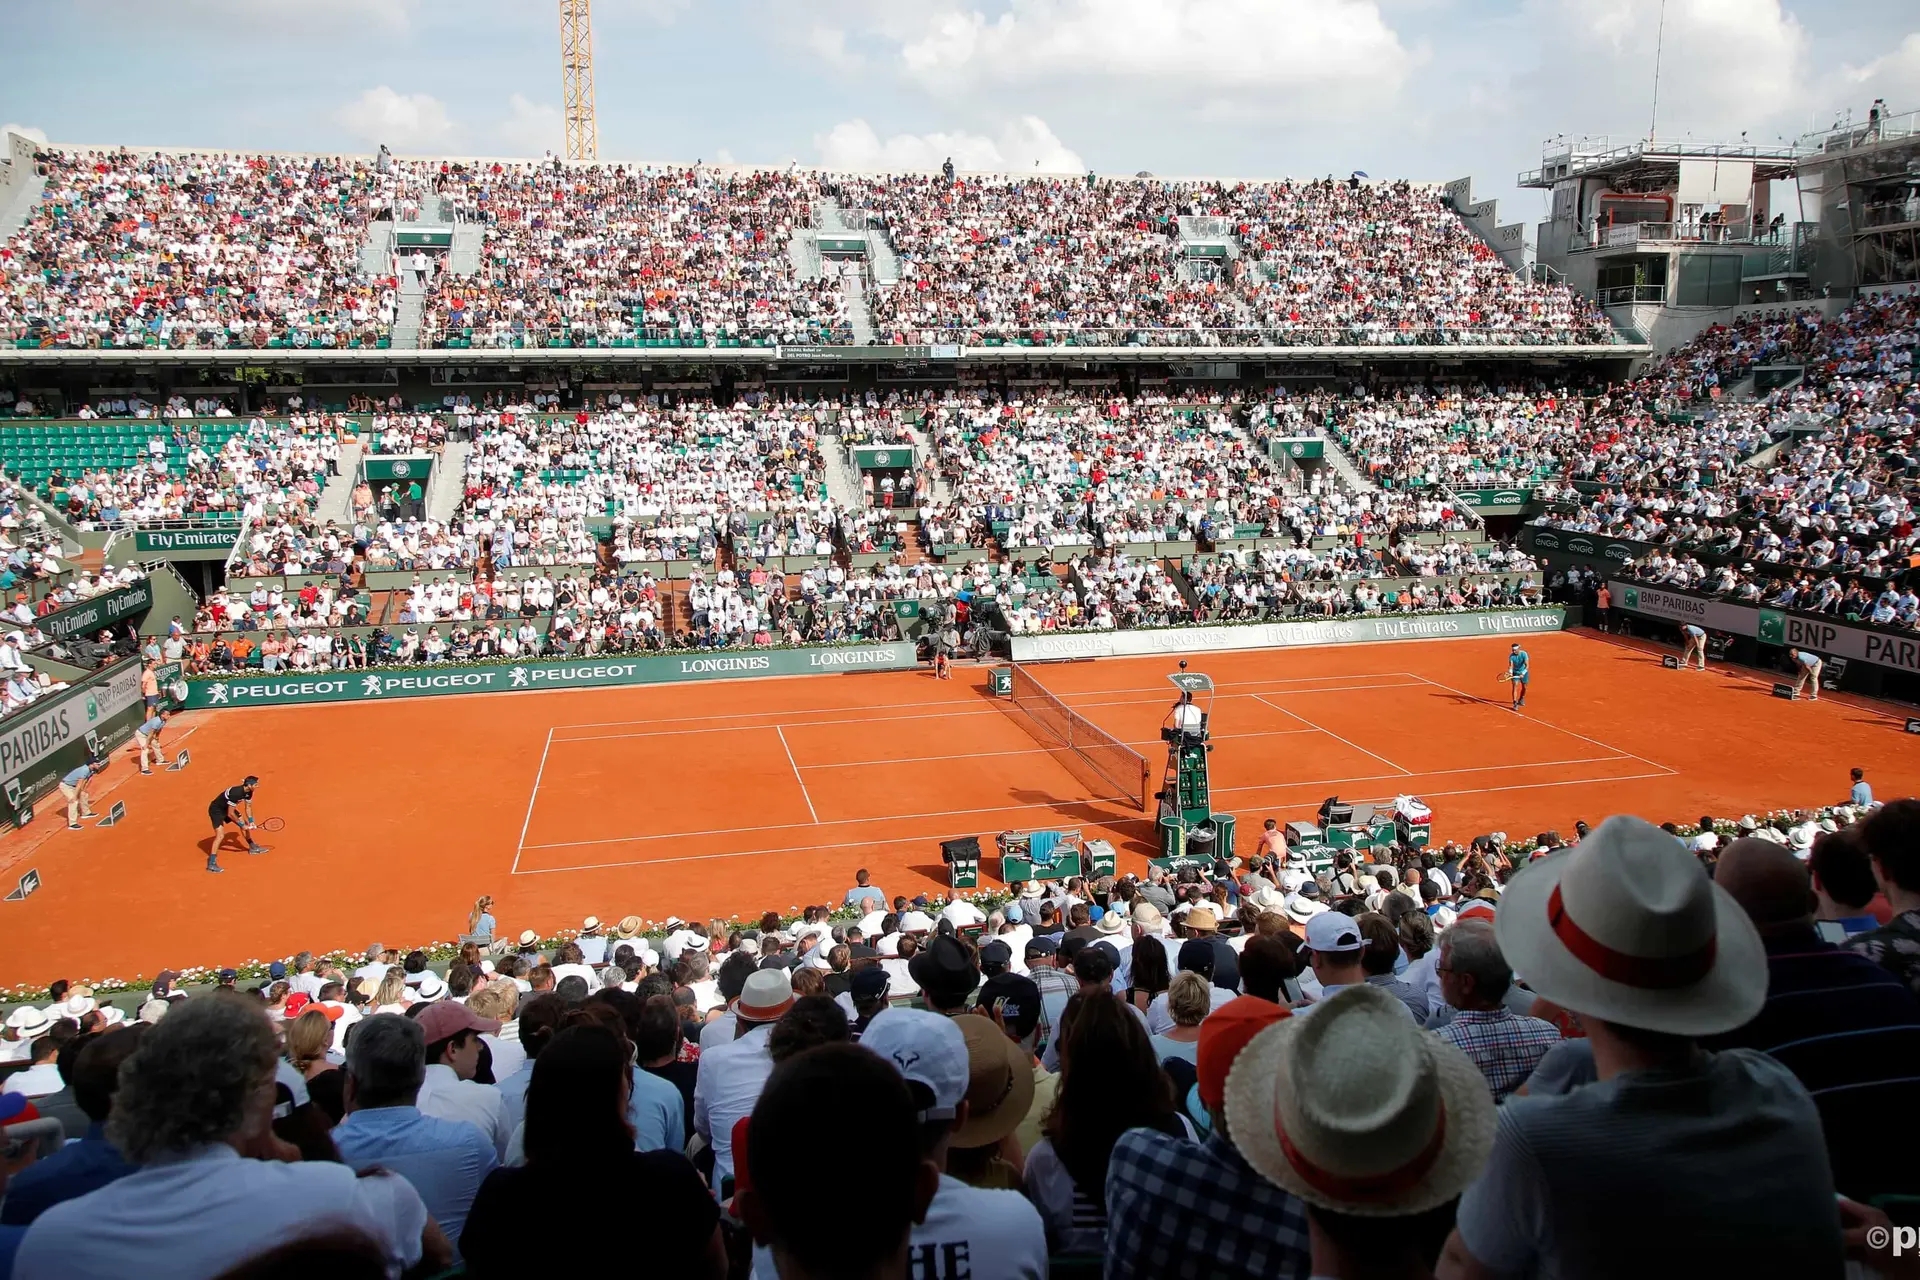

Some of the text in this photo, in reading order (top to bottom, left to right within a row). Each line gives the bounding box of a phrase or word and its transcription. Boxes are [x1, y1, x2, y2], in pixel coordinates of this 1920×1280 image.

[148, 532, 237, 548] Fly Emirates
[107, 589, 147, 616] Fly Emirates
[1641, 591, 1705, 615] BNP PARIBAS
[50, 608, 98, 635] Fly Emirates
[1375, 619, 1458, 637] Fly Emirates
[1478, 613, 1559, 632] Fly Emirates
[1151, 632, 1228, 647] LONGINES
[1266, 624, 1353, 643] Fly Emirates
[1788, 620, 1837, 649] BNP
[1032, 638, 1112, 653] LONGINES
[681, 656, 770, 673] LONGINES
[810, 649, 896, 666] LONGINES
[385, 672, 496, 690] PEUGEOT
[532, 664, 637, 681] PEUGEOT
[111, 674, 137, 698] PARIBAS
[232, 681, 349, 698] PEUGEOT
[0, 709, 70, 774] PARIBAS
